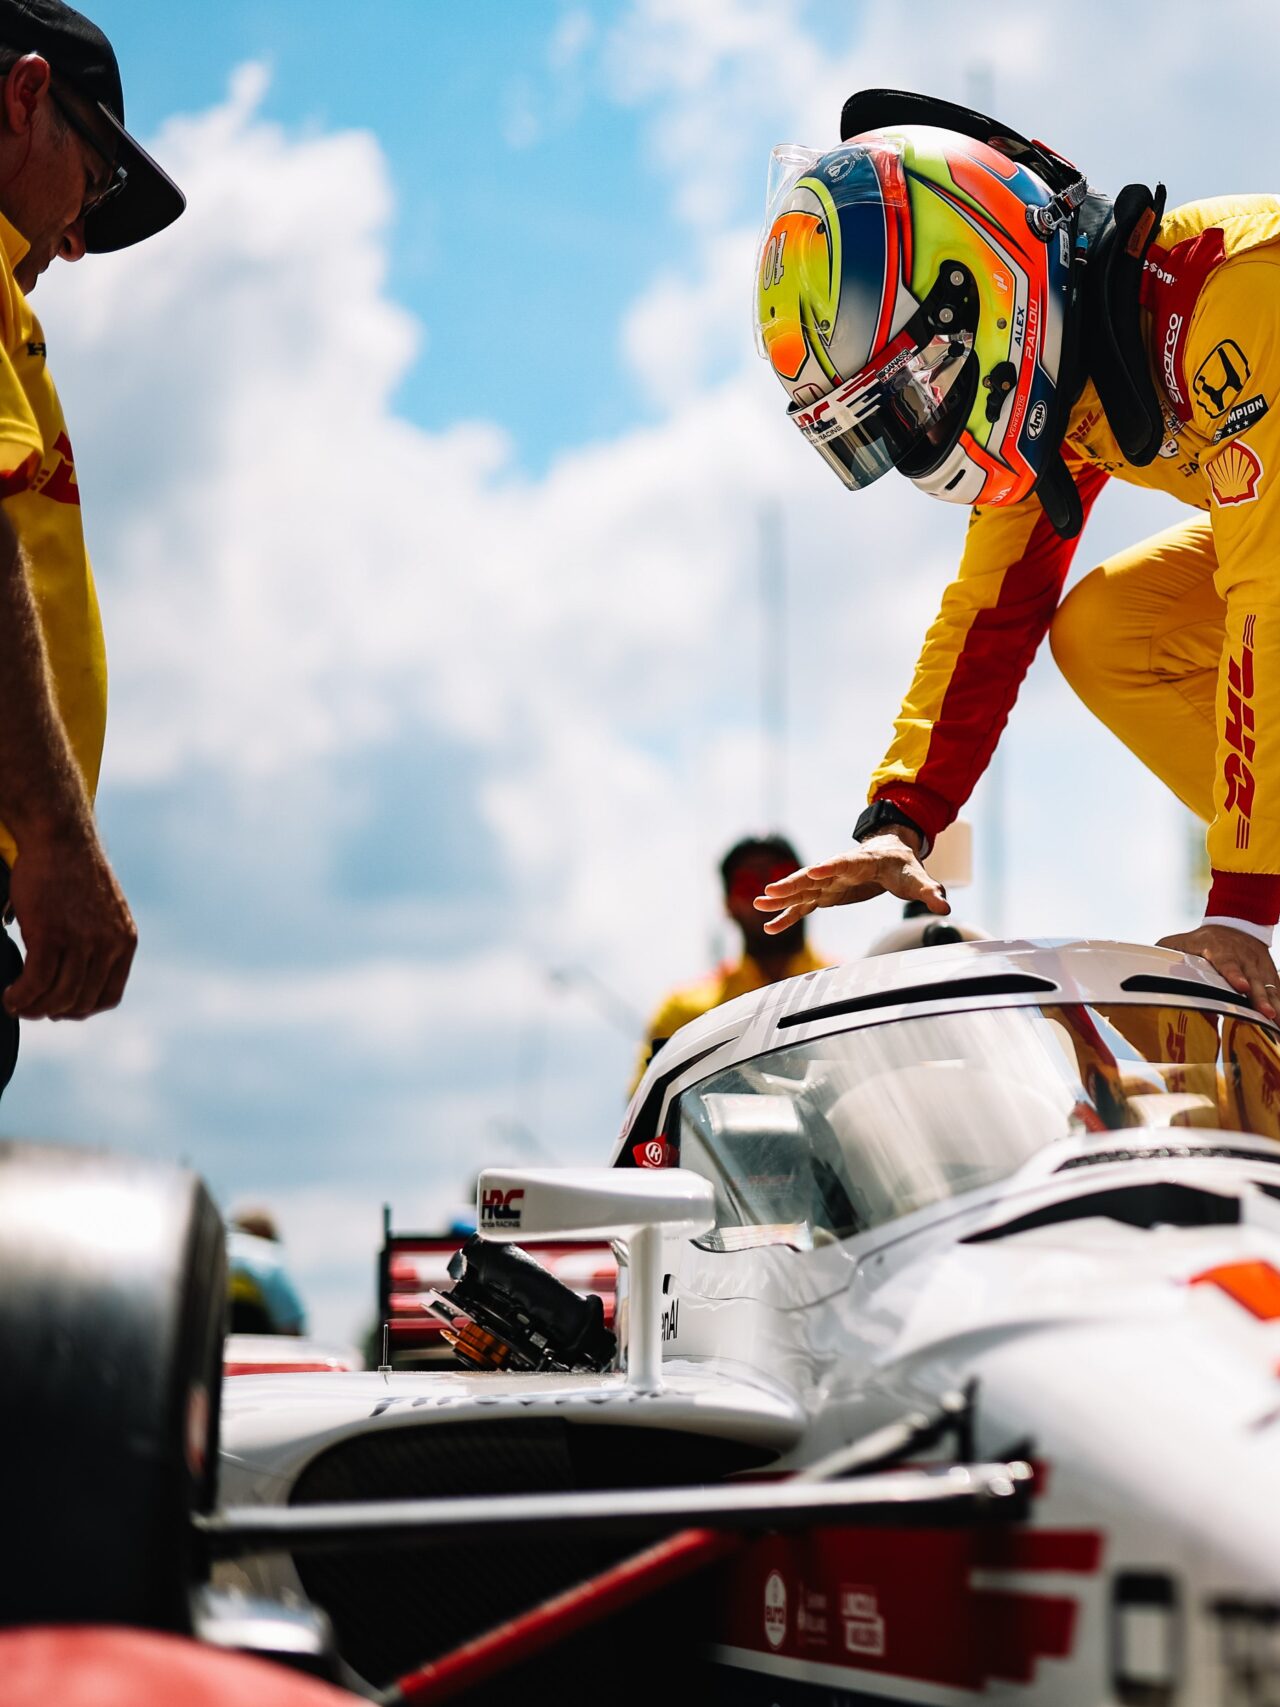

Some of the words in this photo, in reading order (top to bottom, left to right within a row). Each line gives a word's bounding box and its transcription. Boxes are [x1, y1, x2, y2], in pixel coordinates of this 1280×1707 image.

[1014, 305, 1025, 347] ALEX
[1025, 299, 1038, 360] PALOU
[1163, 312, 1184, 405] sparco
[1029, 406, 1044, 436] Arai
[1225, 398, 1265, 426] MPION
[1223, 644, 1256, 821] DHL
[482, 1188, 525, 1220] HRC
